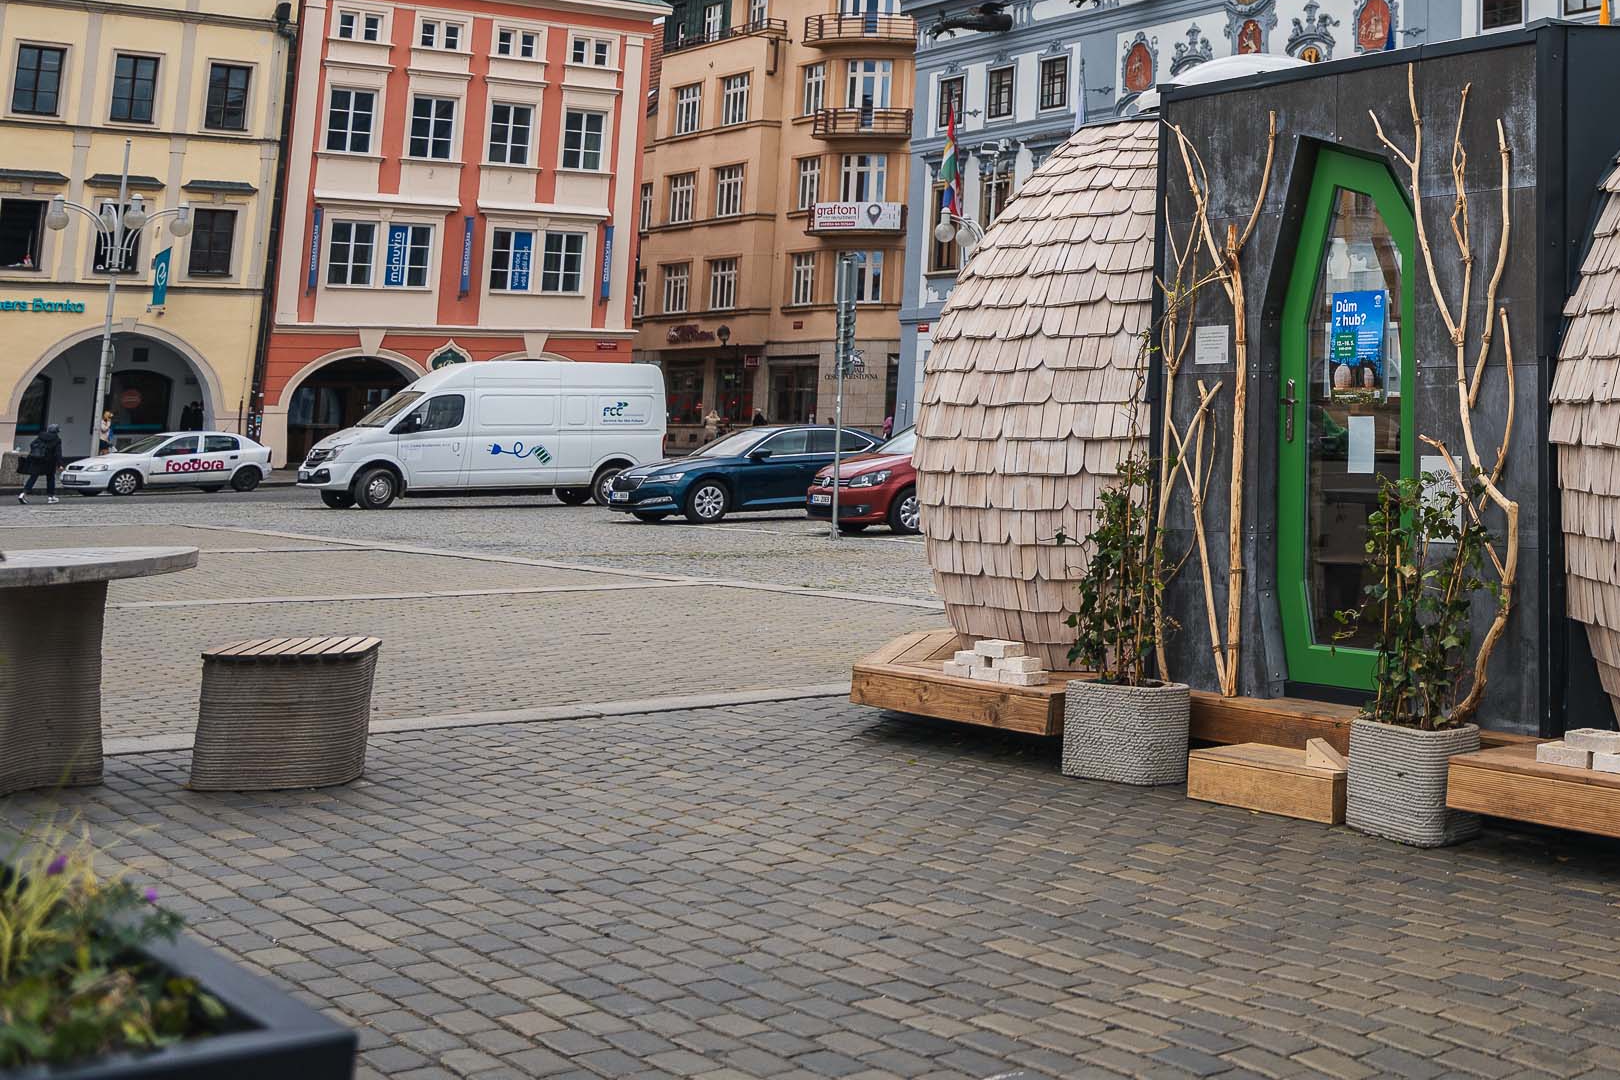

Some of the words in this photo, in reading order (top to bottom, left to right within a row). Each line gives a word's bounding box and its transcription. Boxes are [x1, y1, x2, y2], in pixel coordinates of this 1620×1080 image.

[817, 204, 857, 218] grafton
[390, 231, 403, 282] manuvia
[0, 299, 28, 312] ers
[32, 297, 86, 313] Banka
[1335, 299, 1358, 313] Dům
[1335, 316, 1341, 327] z
[1342, 313, 1367, 327] hub?
[603, 407, 624, 417] FCC
[165, 458, 225, 473] foodora
